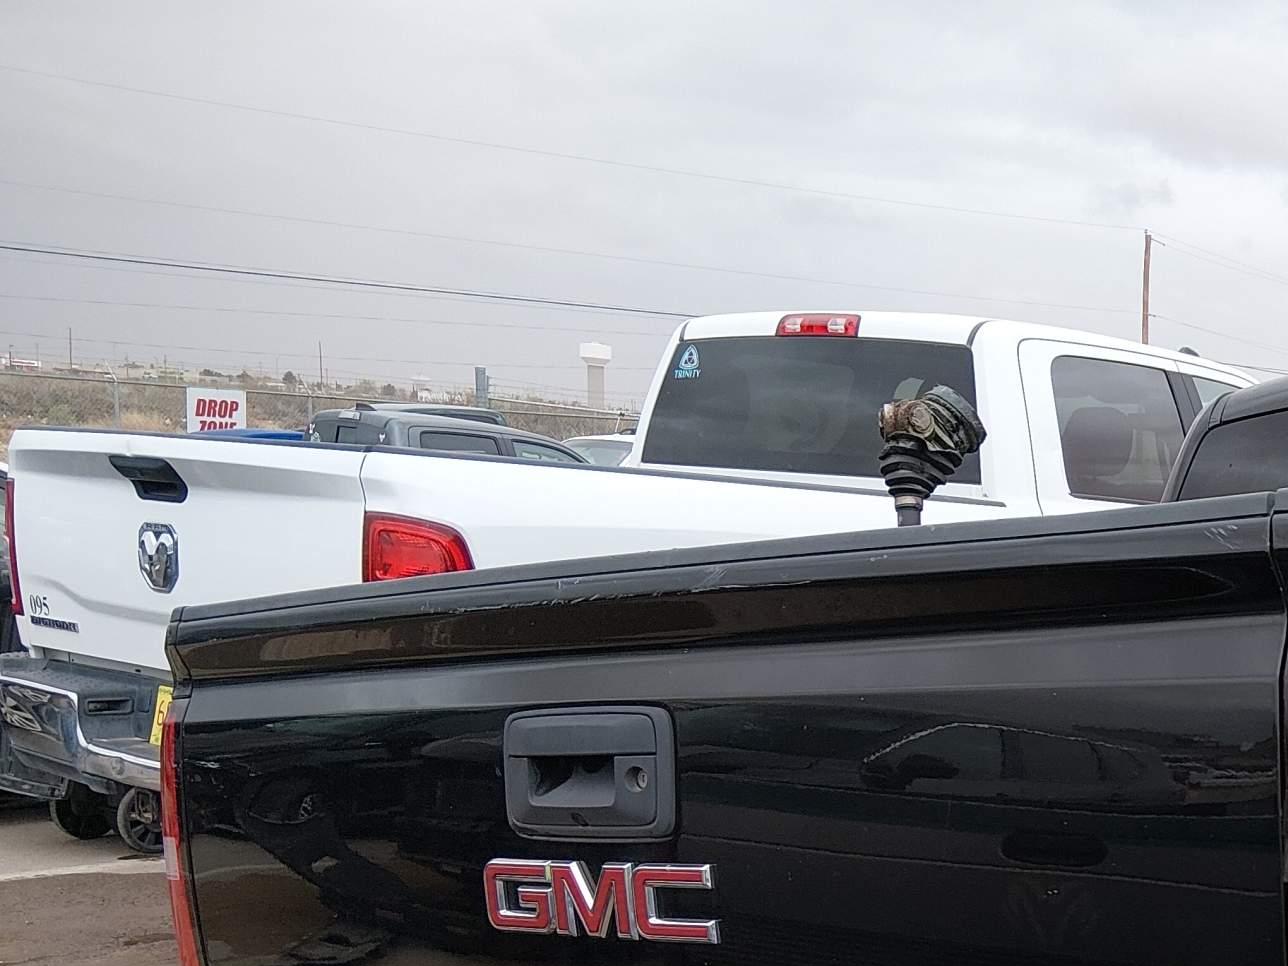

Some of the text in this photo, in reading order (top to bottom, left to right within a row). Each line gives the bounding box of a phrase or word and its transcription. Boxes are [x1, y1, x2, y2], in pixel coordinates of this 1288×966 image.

[674, 369, 701, 379] TRINITY
[195, 398, 239, 418] DROP
[30, 594, 50, 616] 095
[484, 858, 721, 944] GMC
